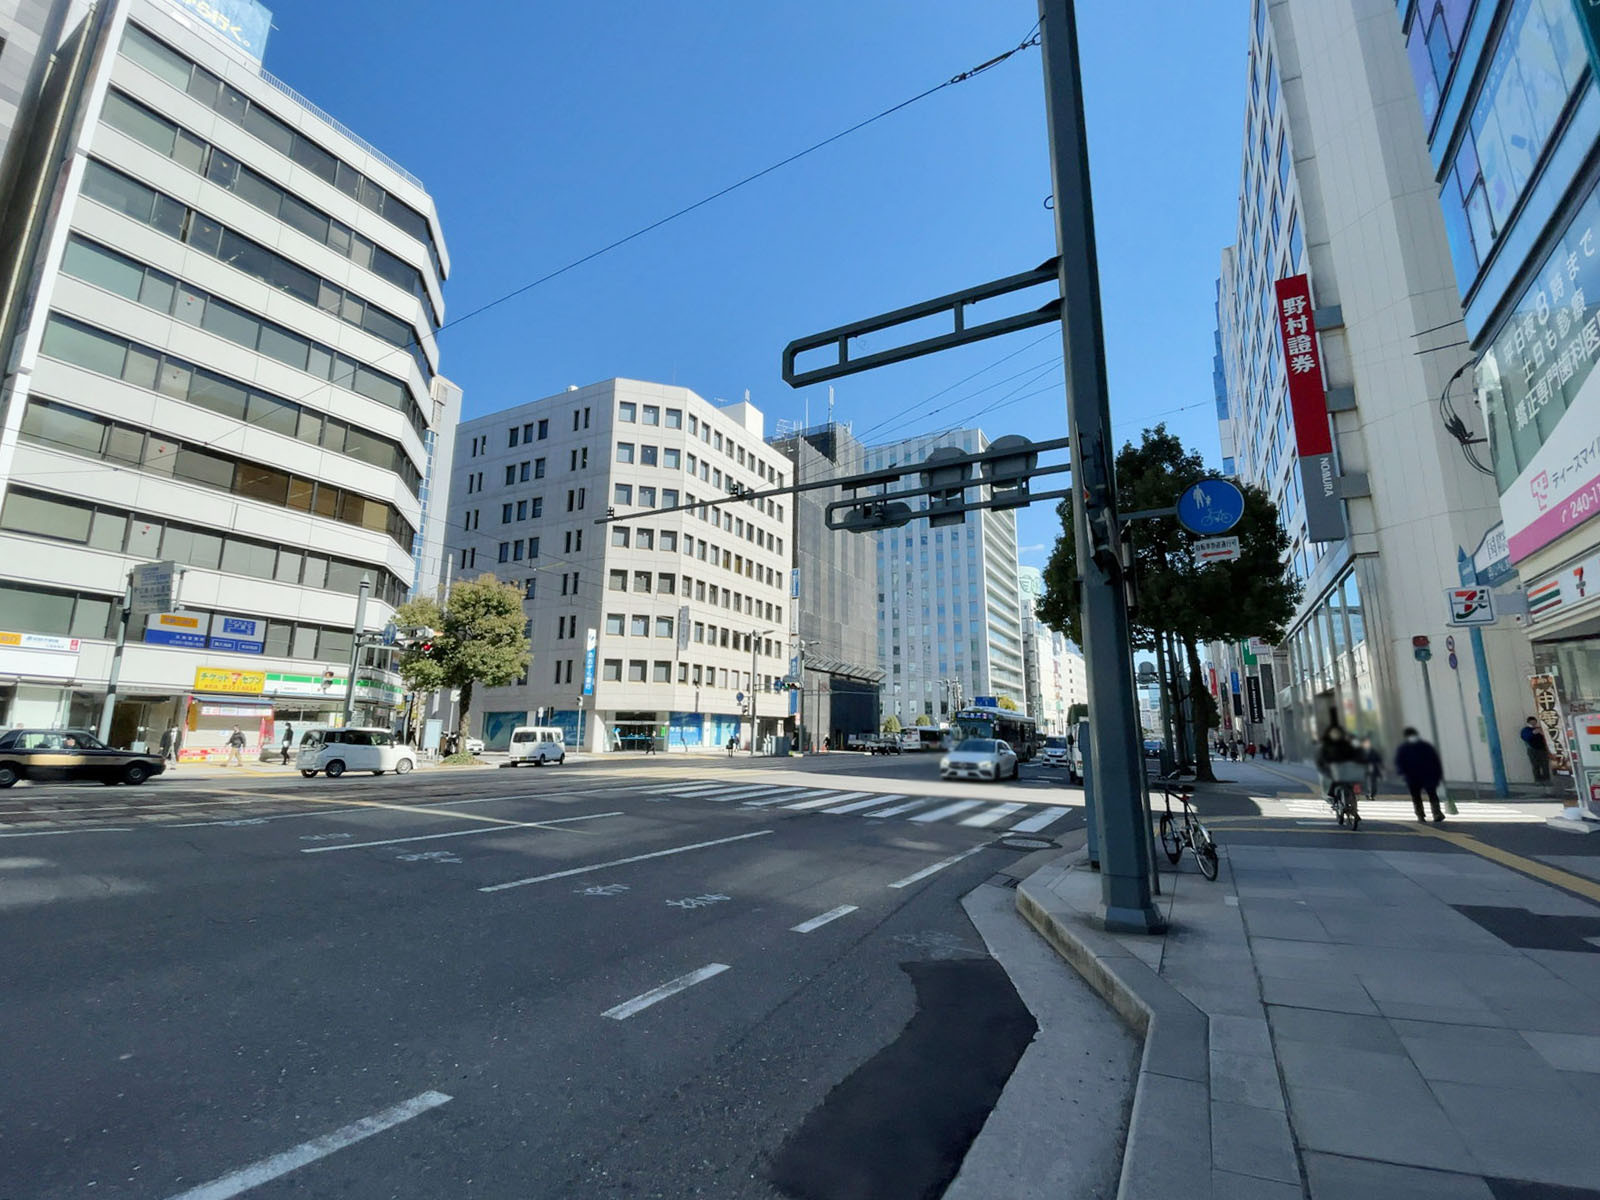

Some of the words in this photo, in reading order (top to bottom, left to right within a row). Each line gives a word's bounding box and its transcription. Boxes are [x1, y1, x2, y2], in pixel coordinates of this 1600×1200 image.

[1282, 295, 1316, 375] 野村證券
[1320, 457, 1334, 497] NOMURA
